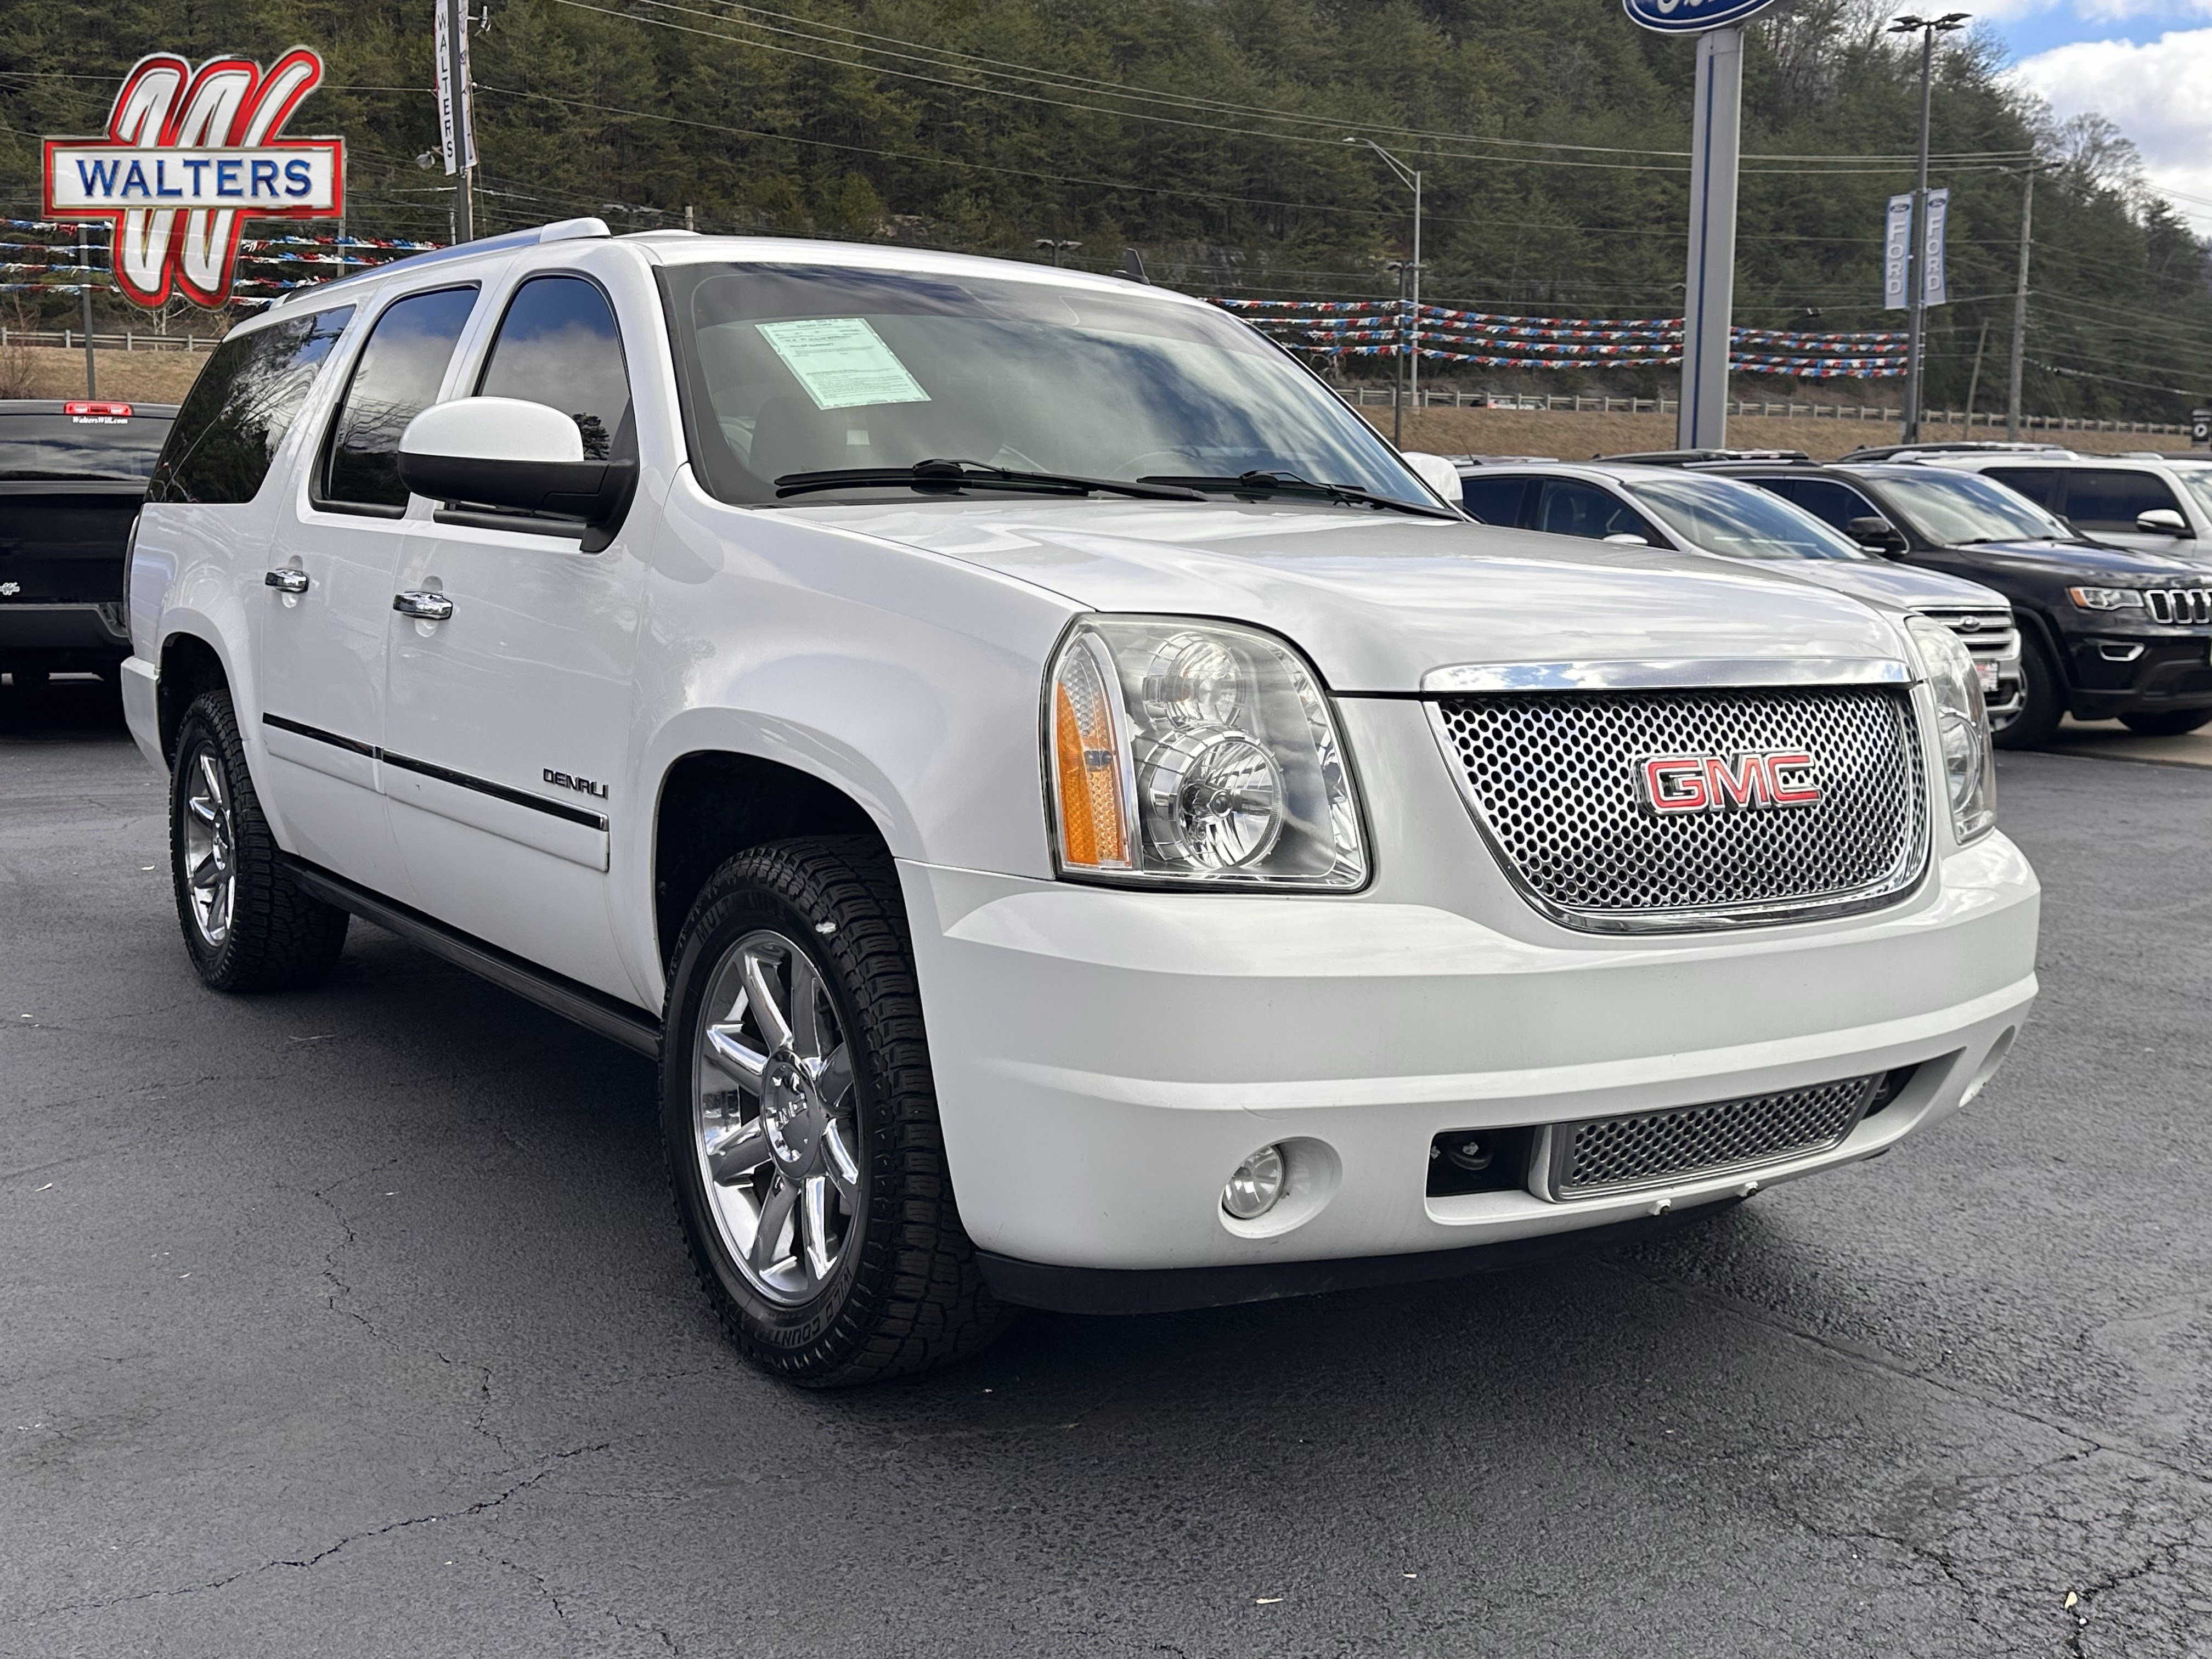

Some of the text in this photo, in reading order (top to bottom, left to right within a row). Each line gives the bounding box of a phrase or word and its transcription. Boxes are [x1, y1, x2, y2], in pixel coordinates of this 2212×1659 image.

[437, 11, 453, 157] WALTERS
[1887, 221, 1906, 296] FORD
[1927, 216, 1942, 291] FORD
[543, 768, 609, 800] DENALI
[1644, 750, 1821, 814] GMC
